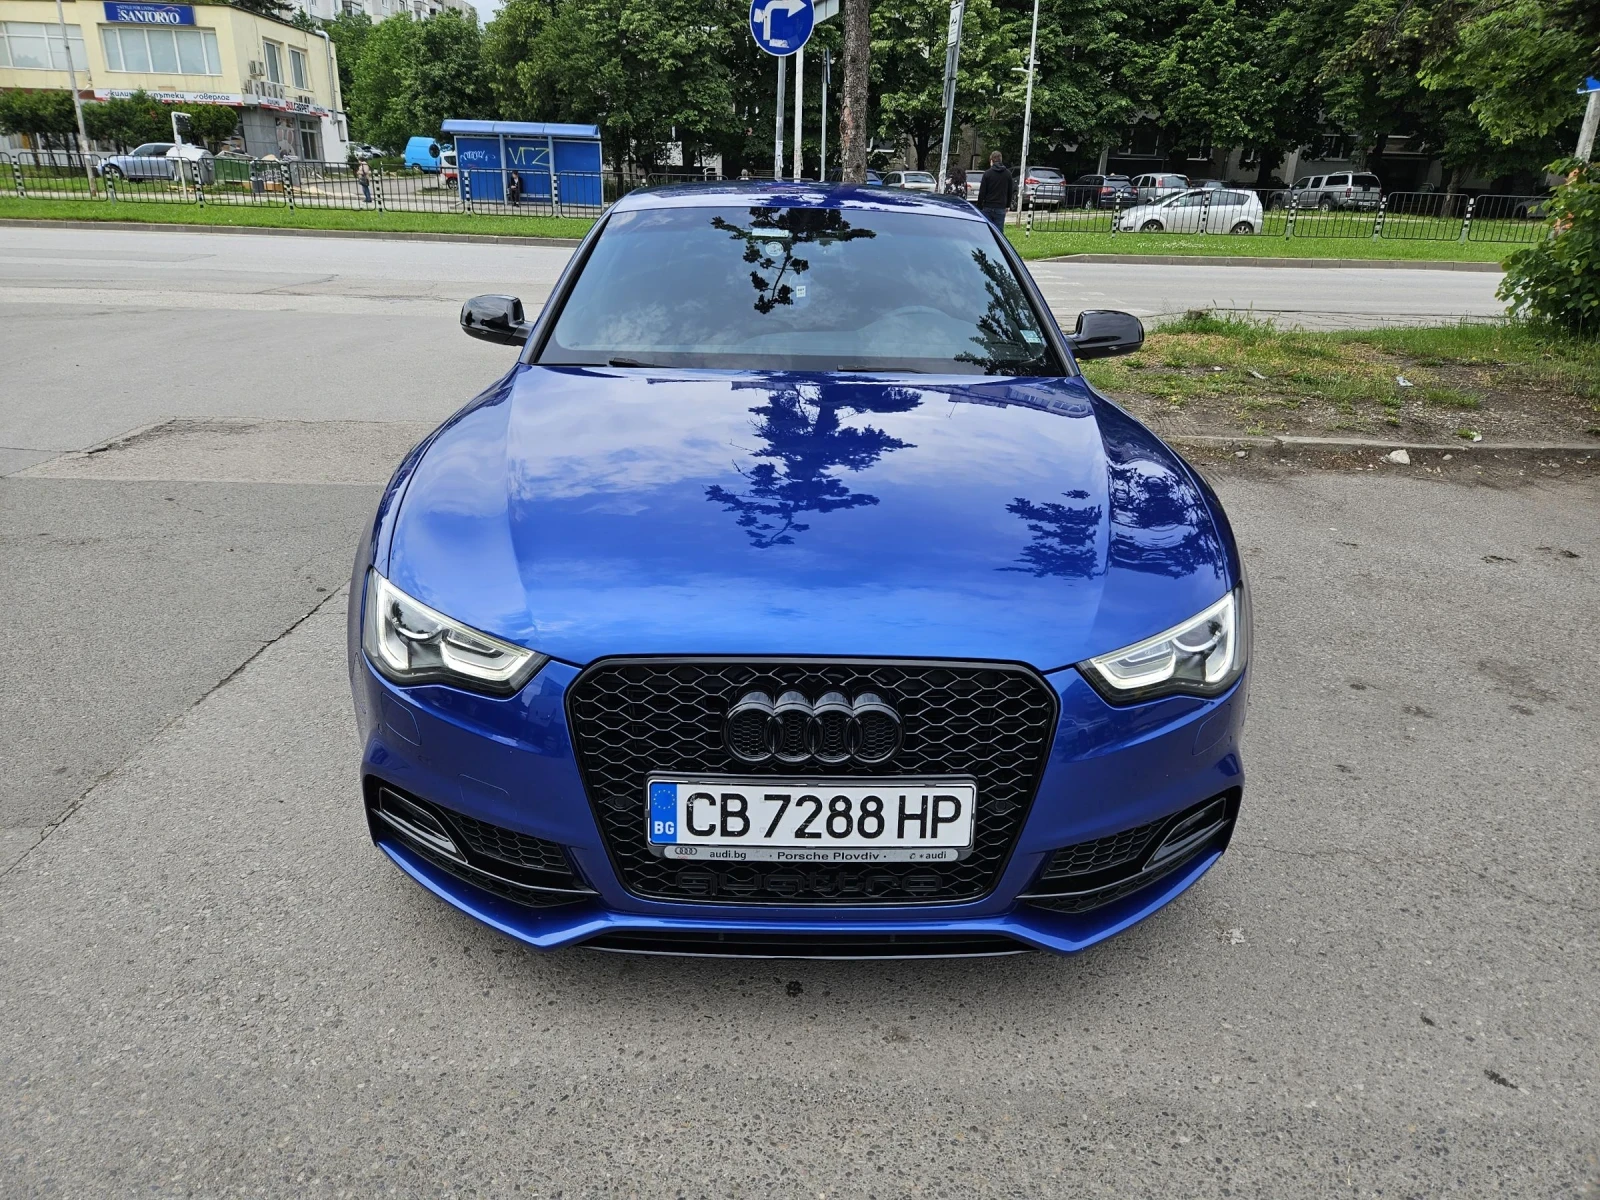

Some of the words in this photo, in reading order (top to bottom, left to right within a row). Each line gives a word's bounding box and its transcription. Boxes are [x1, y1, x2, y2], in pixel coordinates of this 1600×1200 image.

[120, 9, 180, 24] SANTORYO
[199, 92, 230, 101] оверлог
[686, 792, 751, 838] CB
[763, 794, 885, 839] 7288
[896, 795, 962, 839] HP
[654, 820, 675, 835] BG
[709, 850, 747, 860] audi.bg
[777, 851, 830, 861] Porsche
[833, 851, 880, 861] Plovdiv
[675, 871, 944, 897] quattro
